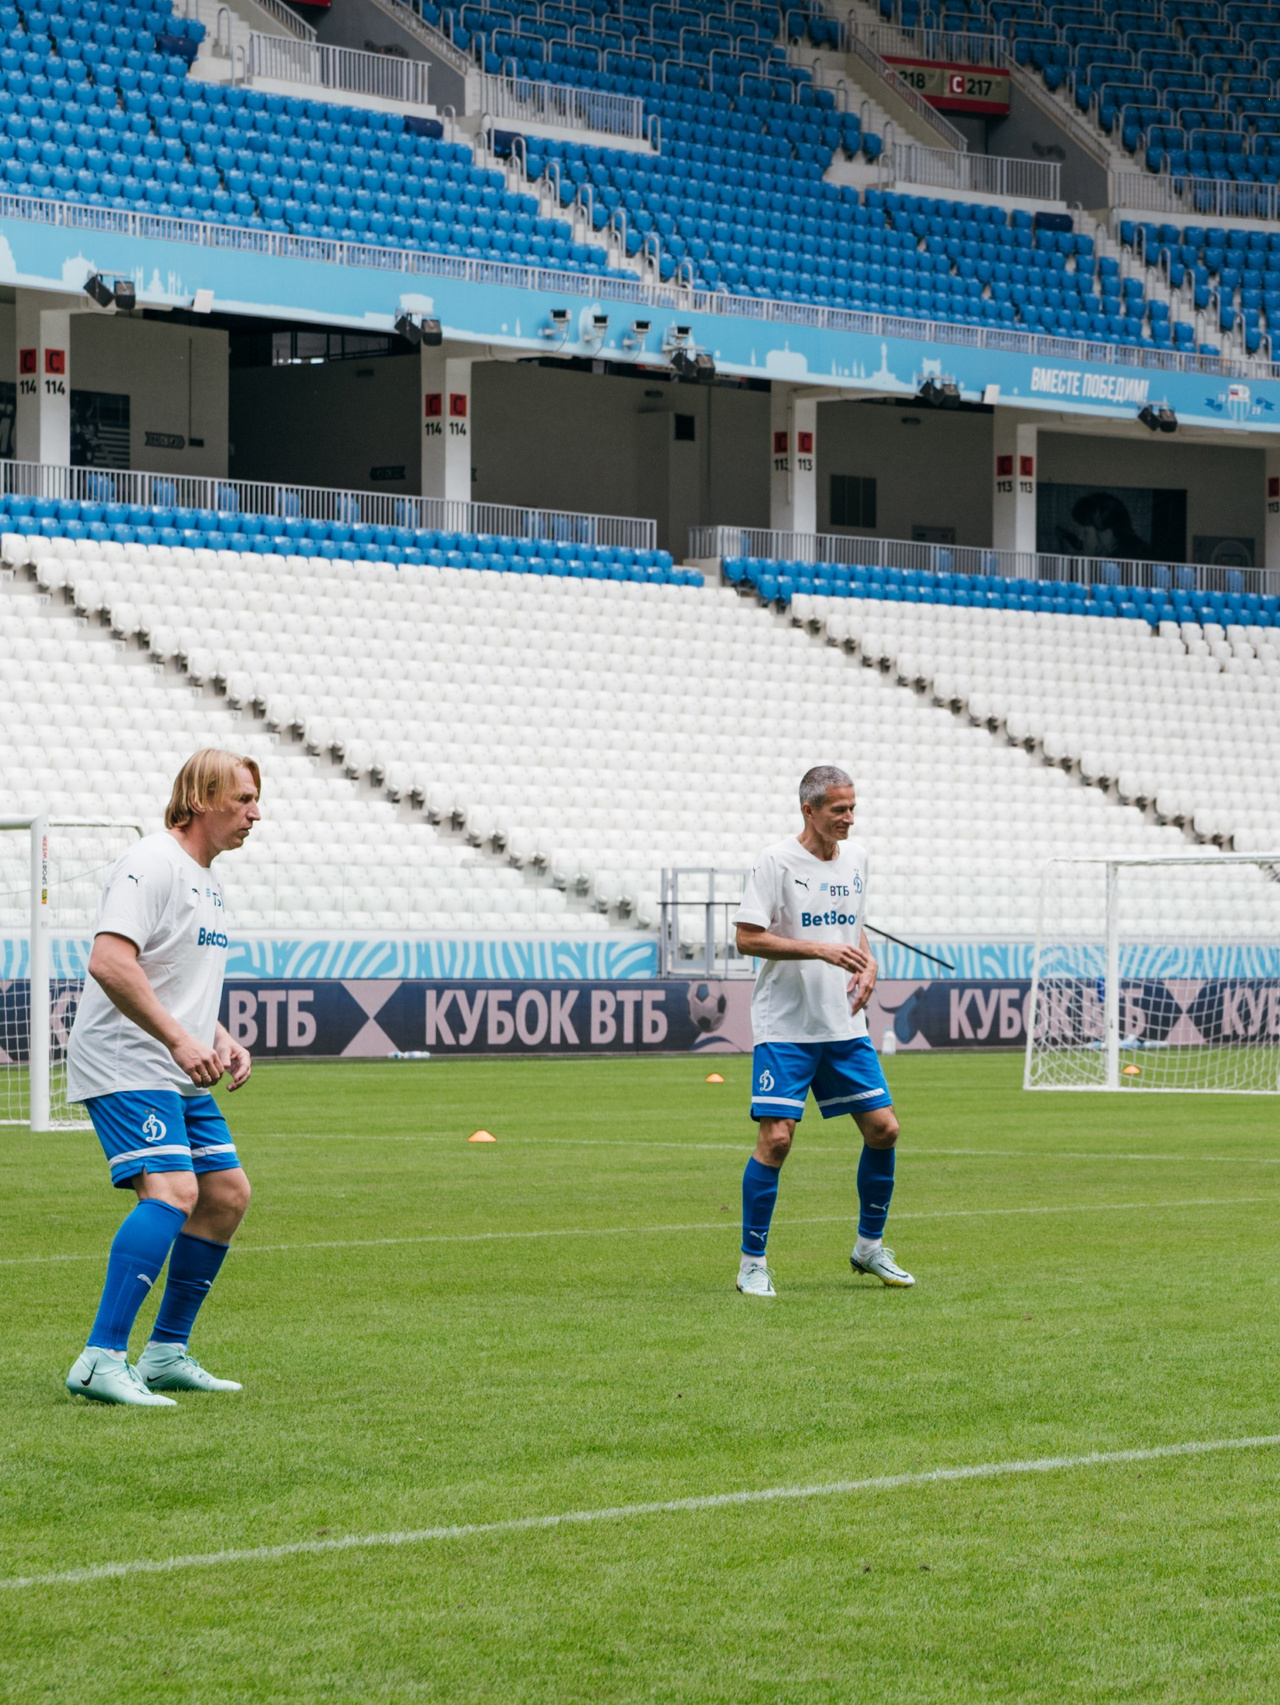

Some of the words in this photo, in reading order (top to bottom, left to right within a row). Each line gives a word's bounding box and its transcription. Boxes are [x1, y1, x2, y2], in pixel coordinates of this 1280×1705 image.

[951, 76, 962, 92] C
[966, 79, 992, 96] 217
[48, 351, 60, 372] C
[20, 379, 37, 394] 114
[45, 380, 65, 395] 114
[1030, 366, 1081, 395] ВМЕСТЕ
[1082, 372, 1150, 403] ПОБЕДИМ!
[454, 395, 463, 414] C
[425, 422, 442, 436] 114
[449, 422, 467, 436] 114
[797, 458, 813, 471] 113
[829, 885, 850, 896] ВТБ
[801, 910, 857, 927] BetBoo
[228, 989, 317, 1048] ВТБ
[425, 989, 580, 1046] КУБОК
[590, 989, 668, 1045] ВТБ
[950, 988, 1074, 1040] КУБОК
[1082, 987, 1147, 1038] ВБ
